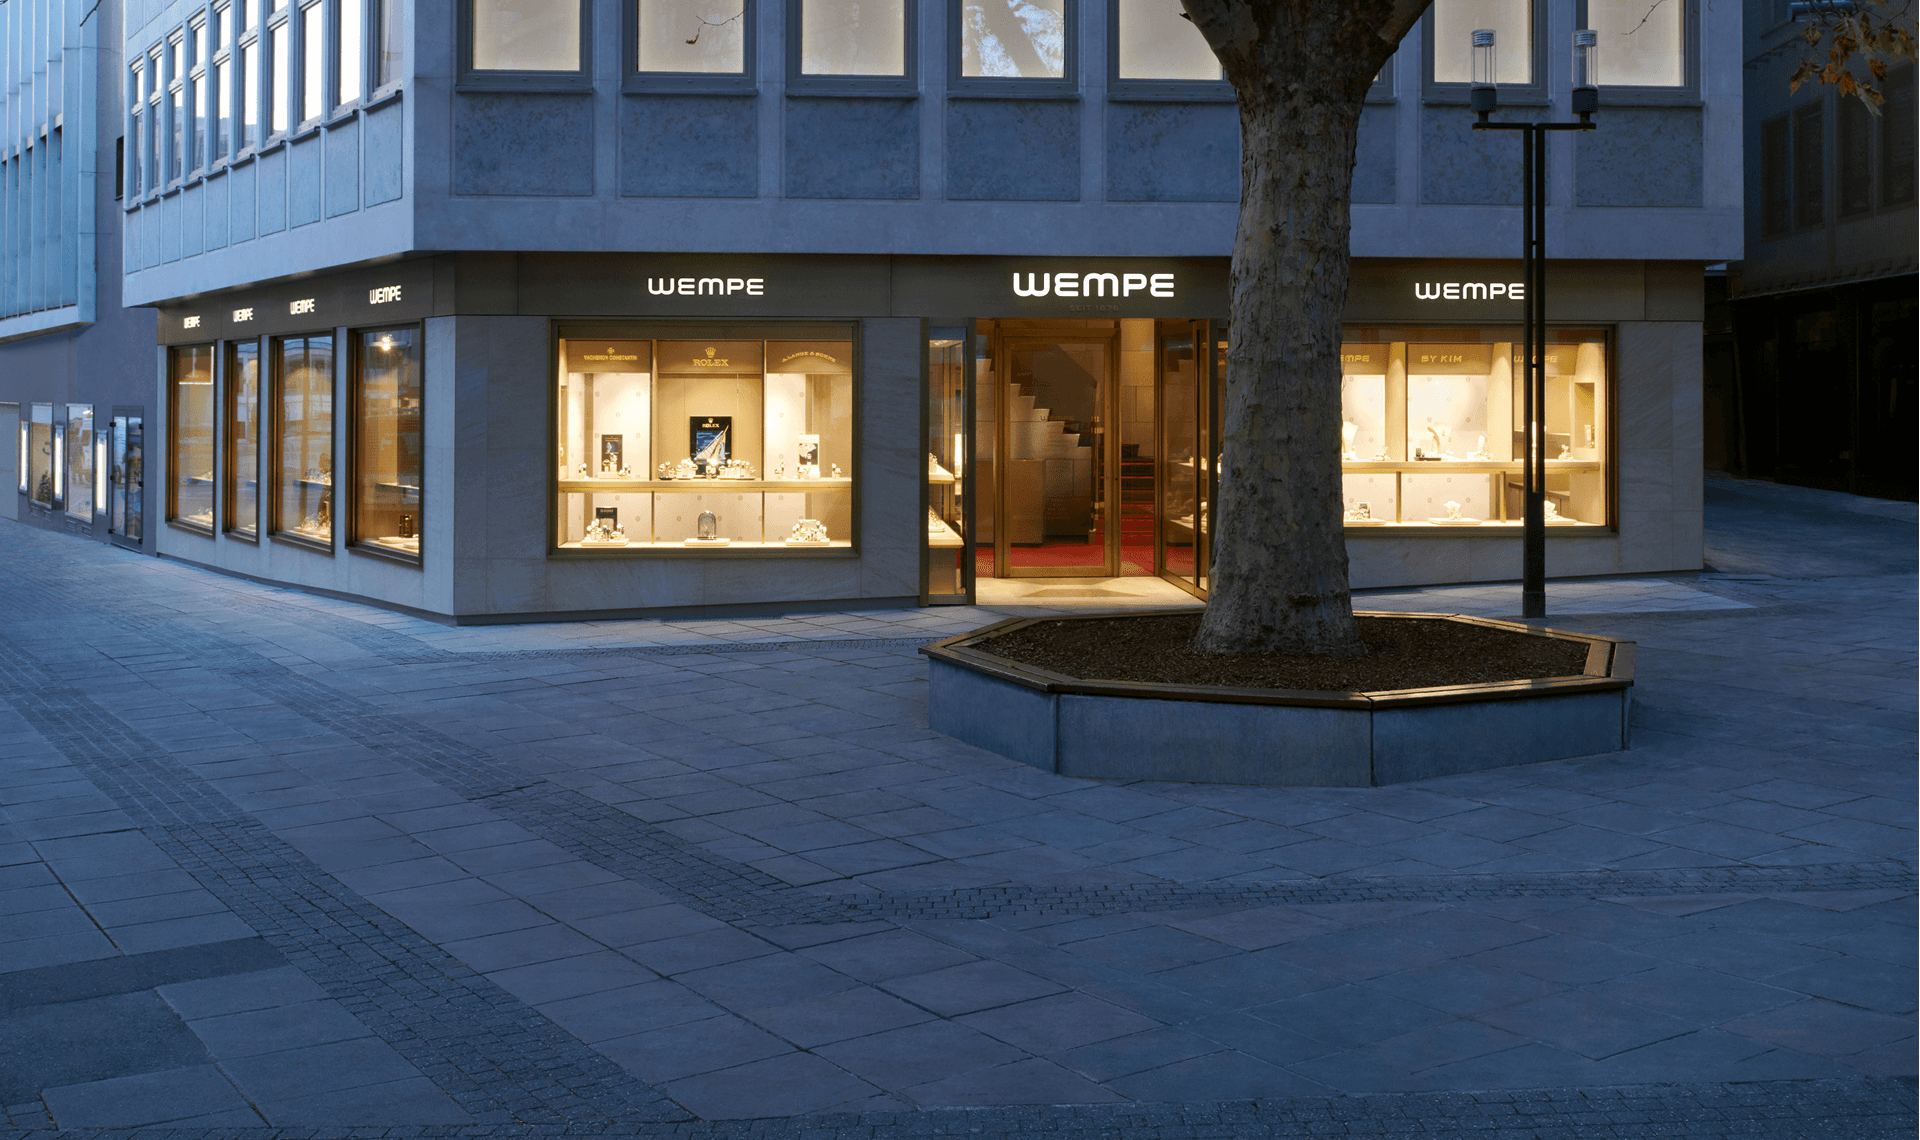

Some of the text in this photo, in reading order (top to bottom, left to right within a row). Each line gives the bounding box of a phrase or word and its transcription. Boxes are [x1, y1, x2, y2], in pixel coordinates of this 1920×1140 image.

[647, 277, 764, 296] WEMPE
[1013, 272, 1174, 298] WEMPE
[1415, 282, 1525, 300] WEMPE
[369, 285, 402, 304] WEMPE
[289, 298, 315, 315] WEMPE
[692, 358, 729, 367] ROLEX
[1440, 355, 1462, 363] KIM
